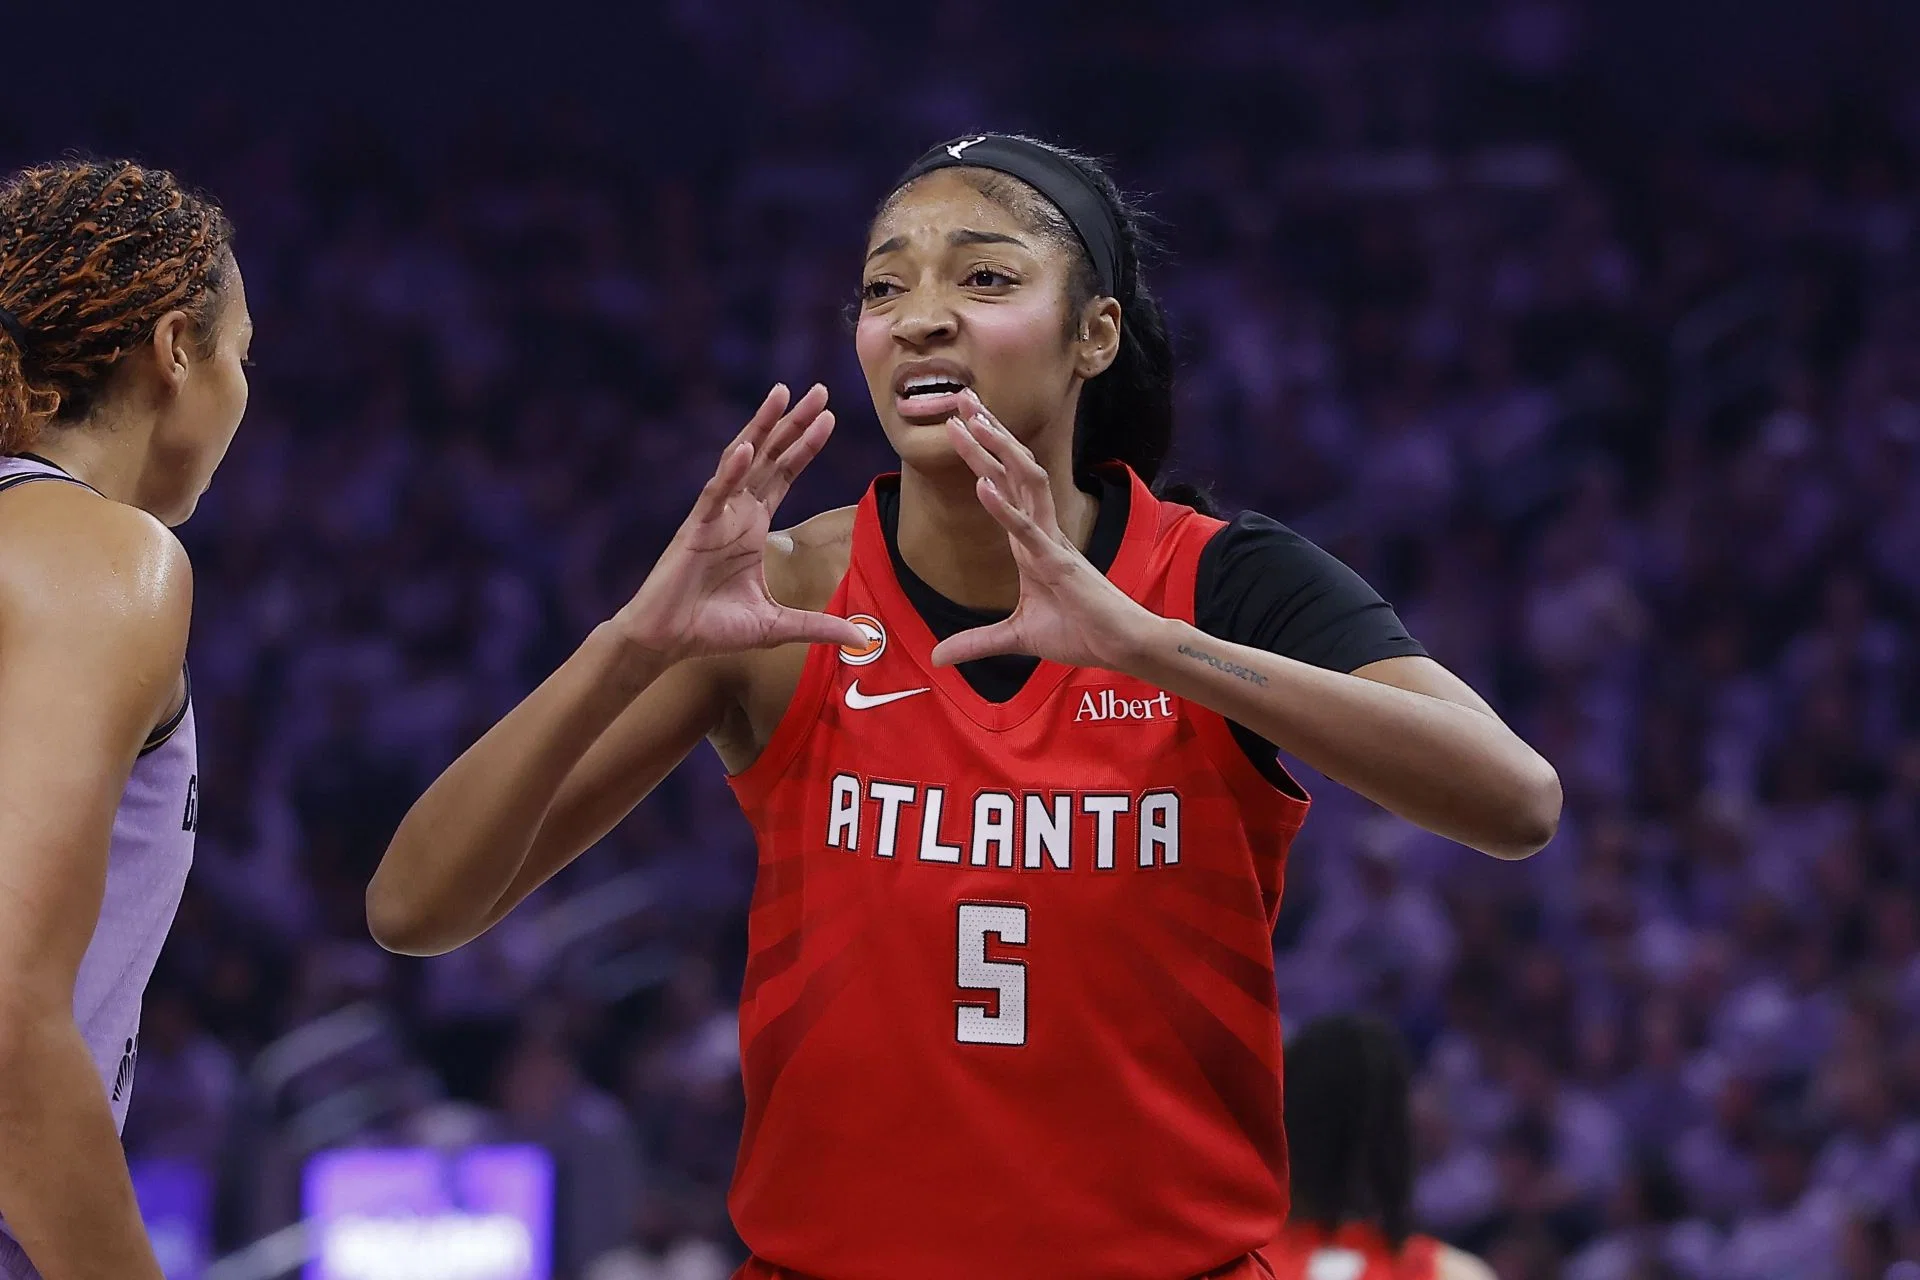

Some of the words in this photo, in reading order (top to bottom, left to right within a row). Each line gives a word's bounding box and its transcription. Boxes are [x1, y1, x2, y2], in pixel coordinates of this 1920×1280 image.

[1073, 689, 1173, 722] Albert
[826, 772, 1182, 870] ATLANTA
[956, 904, 1027, 1045] 5
